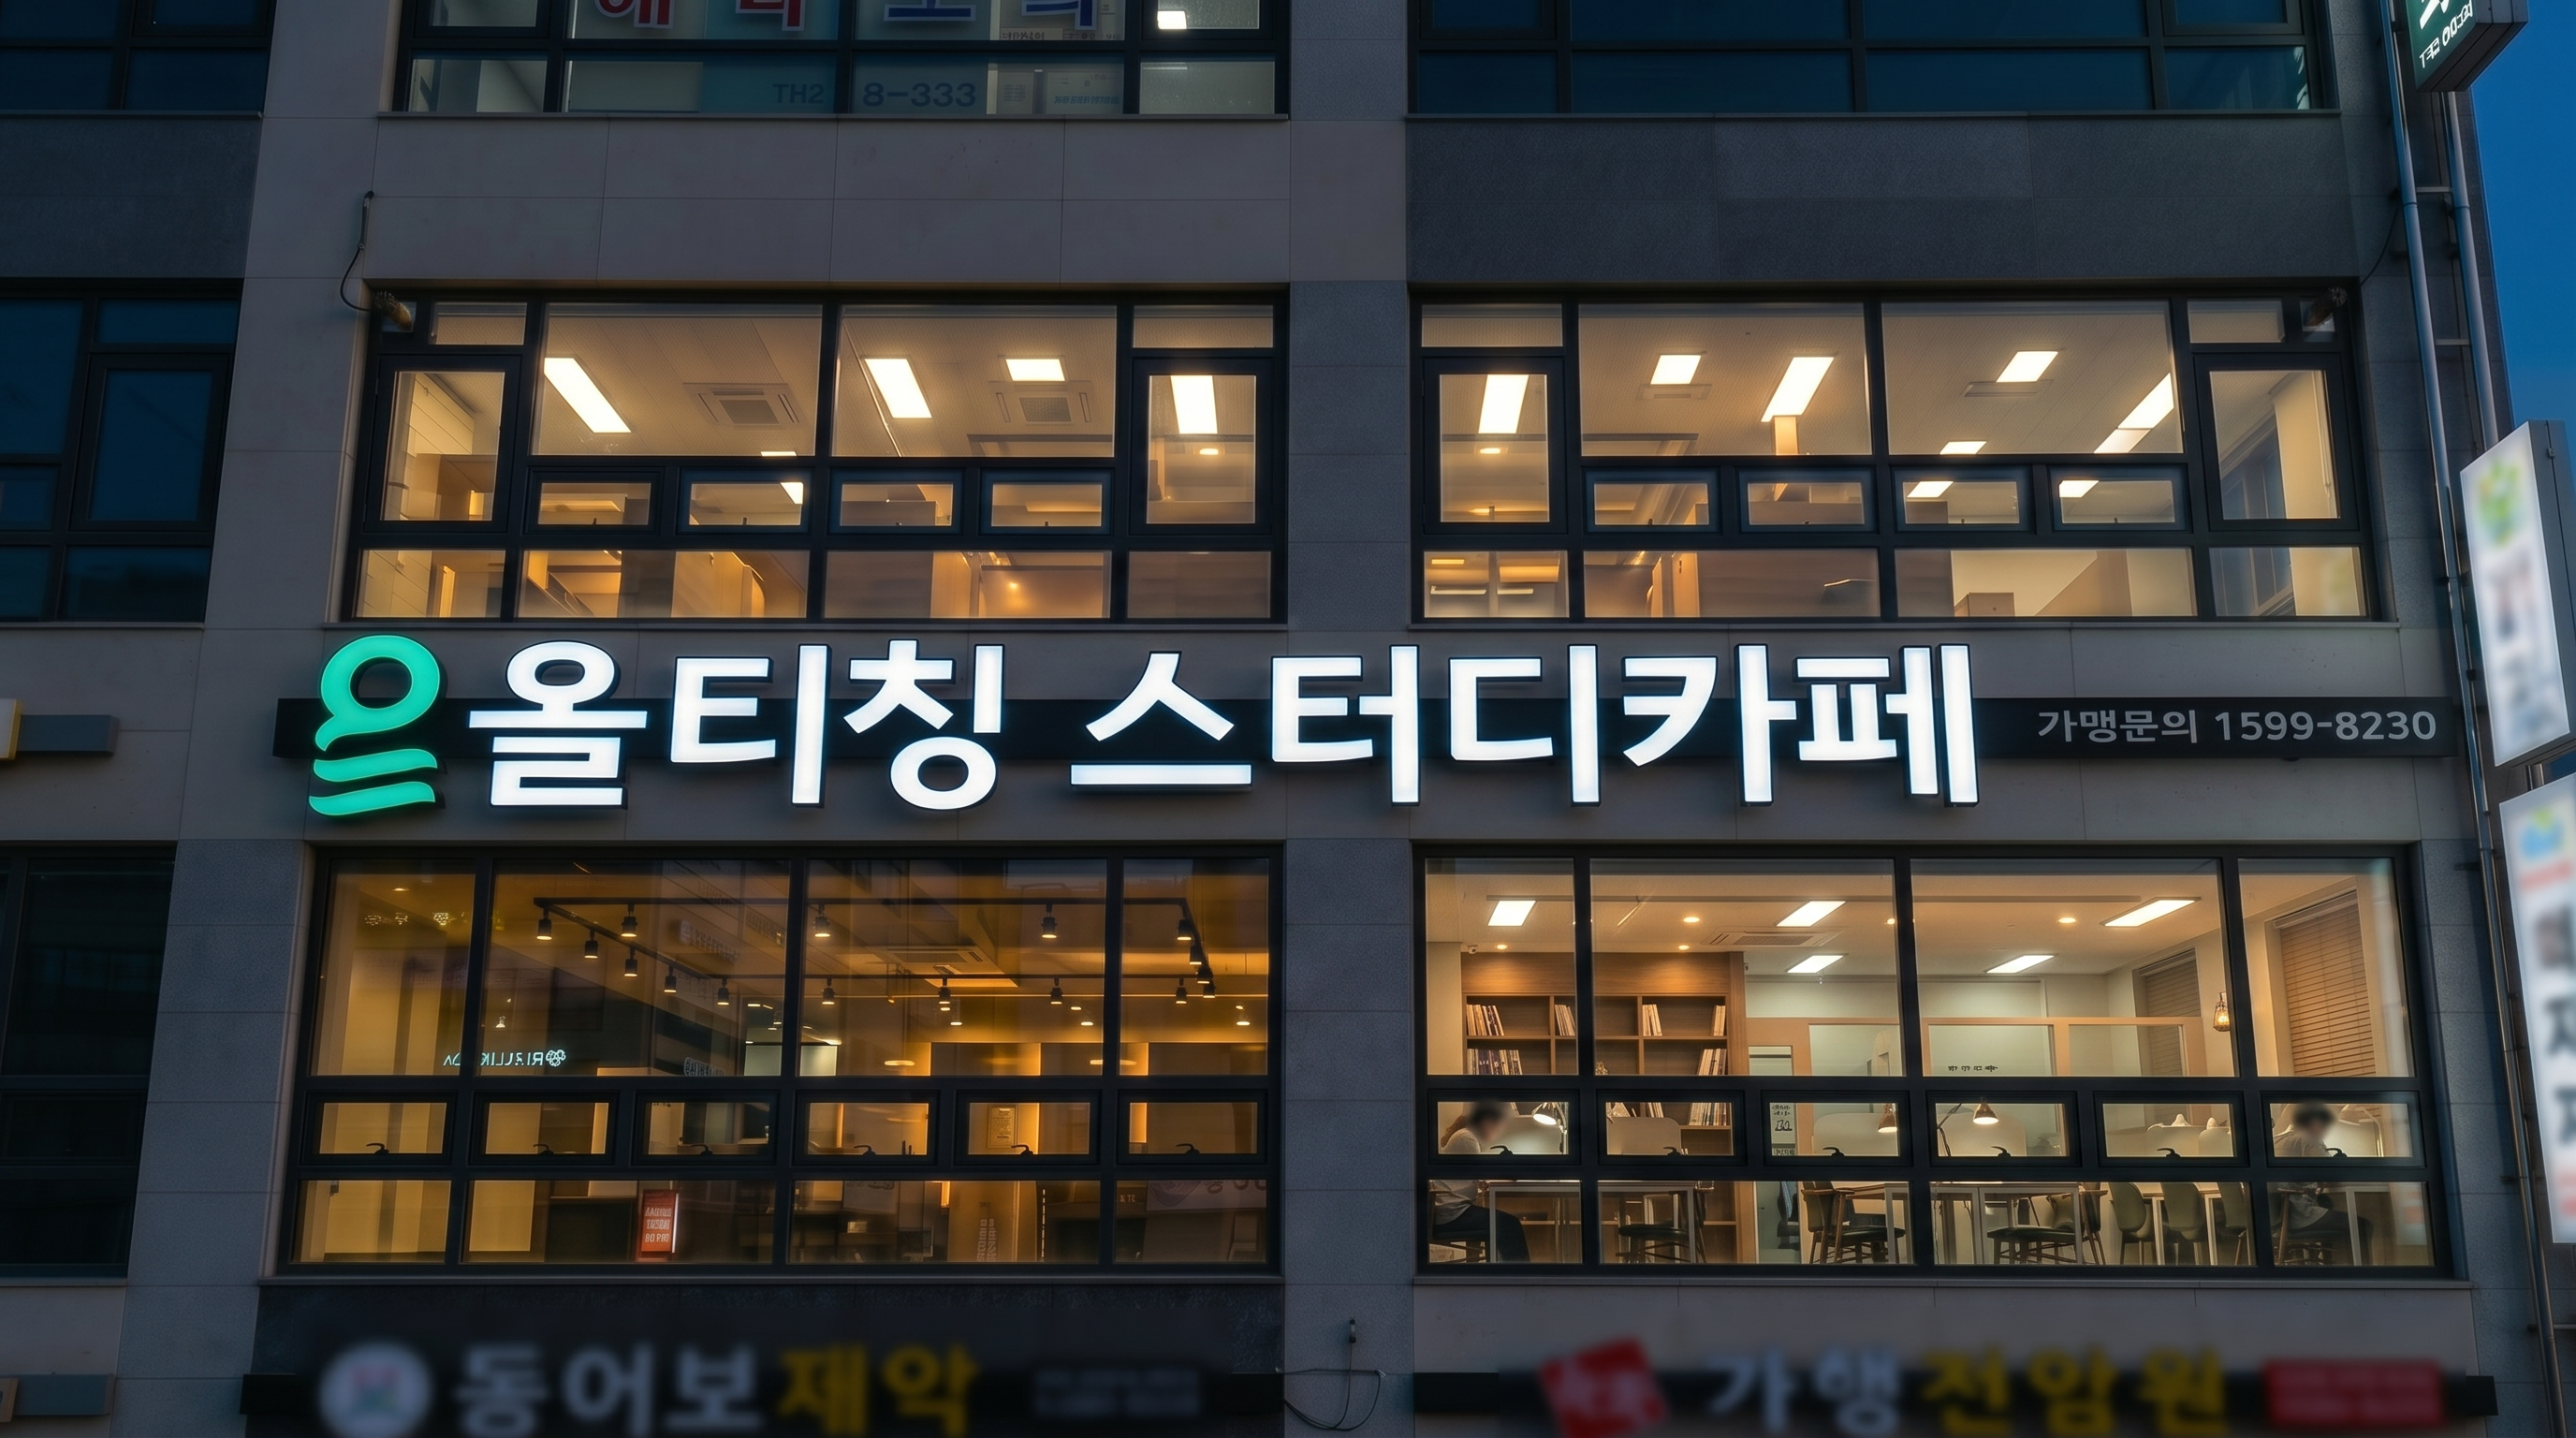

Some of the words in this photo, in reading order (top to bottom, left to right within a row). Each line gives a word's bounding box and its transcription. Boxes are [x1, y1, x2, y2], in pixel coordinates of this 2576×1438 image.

[469, 639, 1005, 811] 올티칭
[1070, 643, 1980, 805] 스터디카페
[2038, 710, 2198, 743] 가맹문의
[2215, 711, 2437, 741] 1599-8230
